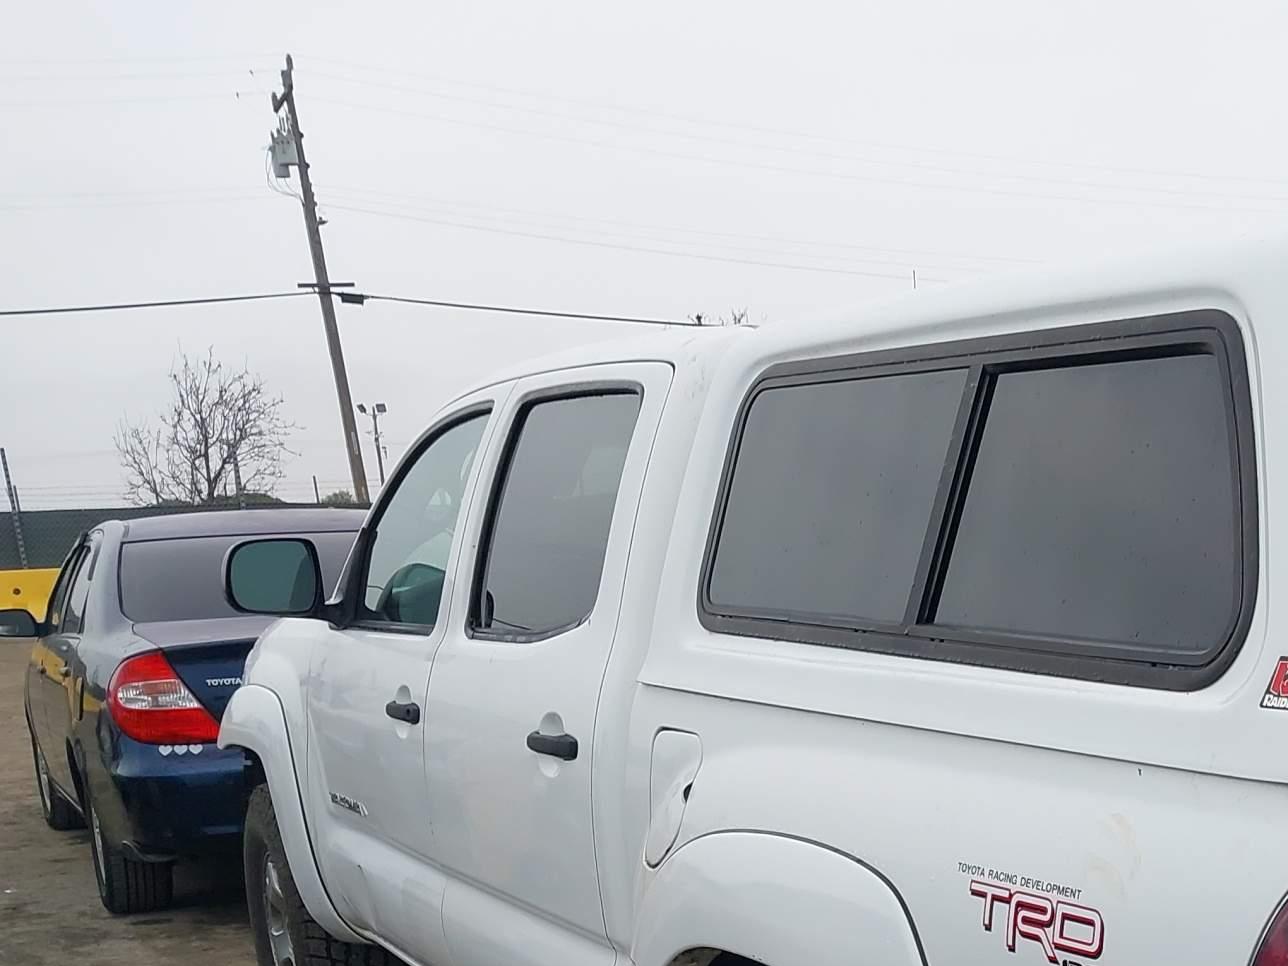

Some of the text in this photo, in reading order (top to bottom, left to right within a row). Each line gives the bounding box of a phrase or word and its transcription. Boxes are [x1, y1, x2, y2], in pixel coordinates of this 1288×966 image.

[205, 677, 242, 687] TOYOTA
[957, 861, 1083, 900] TOYOTA RACING DEVELOPMENT
[968, 879, 1105, 966] TRD
